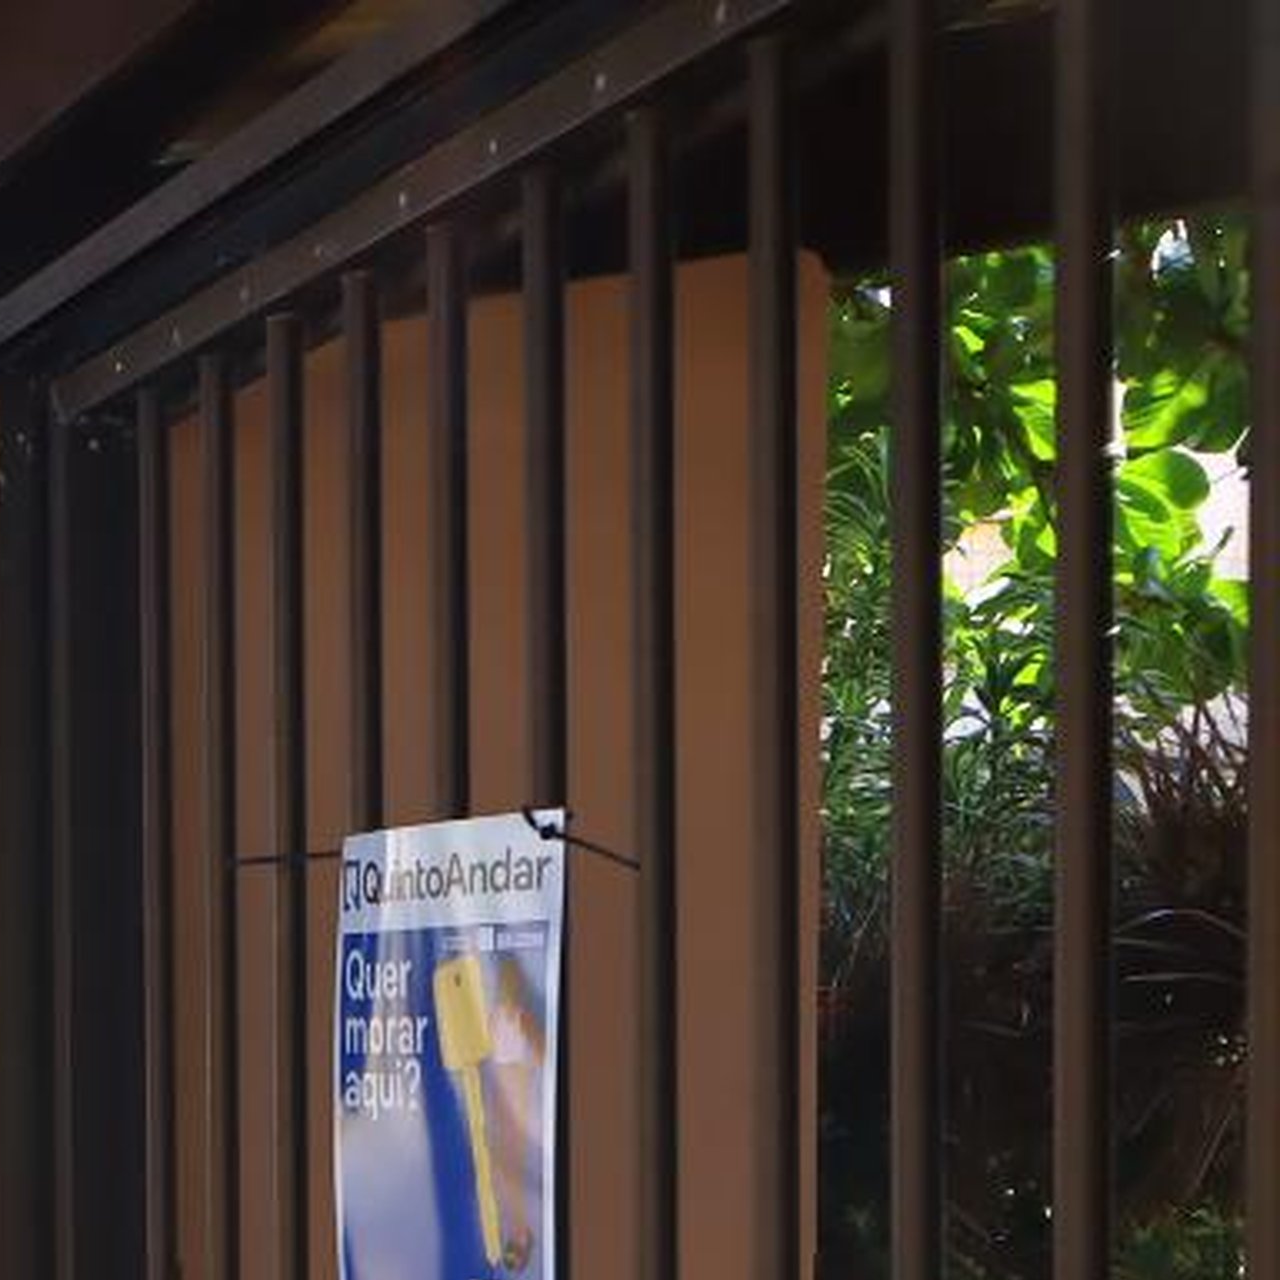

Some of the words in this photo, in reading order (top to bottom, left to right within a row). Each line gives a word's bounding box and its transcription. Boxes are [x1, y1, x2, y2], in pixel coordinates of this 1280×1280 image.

[345, 948, 412, 1000] Quer
[345, 1014, 428, 1055] morar
[344, 1056, 421, 1121] aqui?
